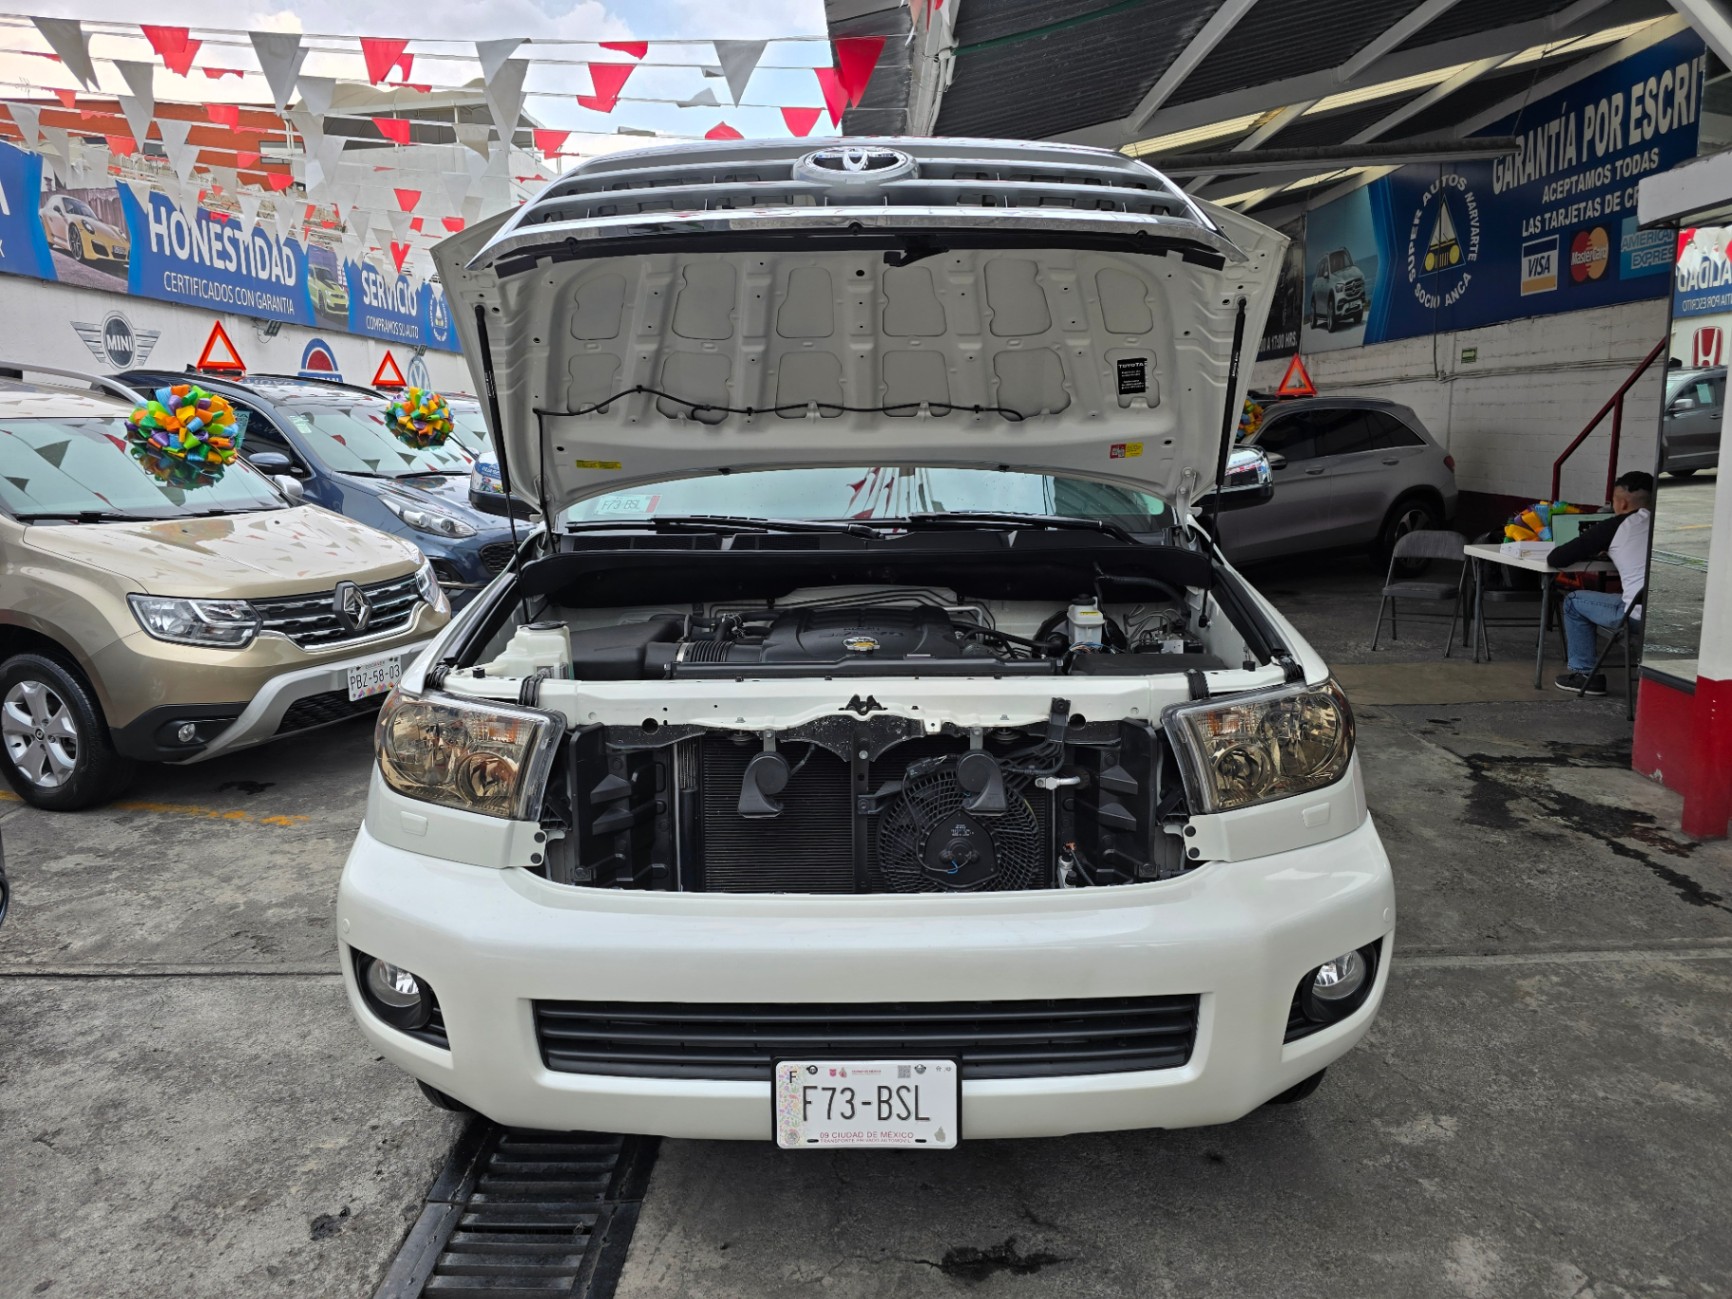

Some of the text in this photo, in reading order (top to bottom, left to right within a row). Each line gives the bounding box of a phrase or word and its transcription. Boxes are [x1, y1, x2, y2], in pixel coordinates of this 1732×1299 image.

[1492, 101, 1577, 196] GARANTÍA
[1582, 92, 1623, 163] POR
[1541, 147, 1660, 204] ACEPTAMOS TODAS
[1422, 174, 1468, 207] AUTOS
[1464, 191, 1480, 262] NARVARTE
[1522, 212, 1542, 237] LAS
[1543, 198, 1601, 234] TARJETAS
[1604, 191, 1622, 213] DE
[148, 202, 297, 287] HONESTIDAD
[1570, 247, 1608, 266] MasterCard
[1528, 255, 1551, 278] VISA
[163, 271, 296, 316] CERTIFICADOS CON GARANTIA
[361, 270, 418, 317] SERVICIO
[1445, 272, 1472, 307] ANCA
[106, 334, 133, 352] MINI
[366, 315, 399, 336] COMPRAMOS
[802, 1085, 931, 1122] F73-BSL
[831, 1131, 864, 1139] CIUDAD
[880, 1130, 914, 1139] MÉXICO
